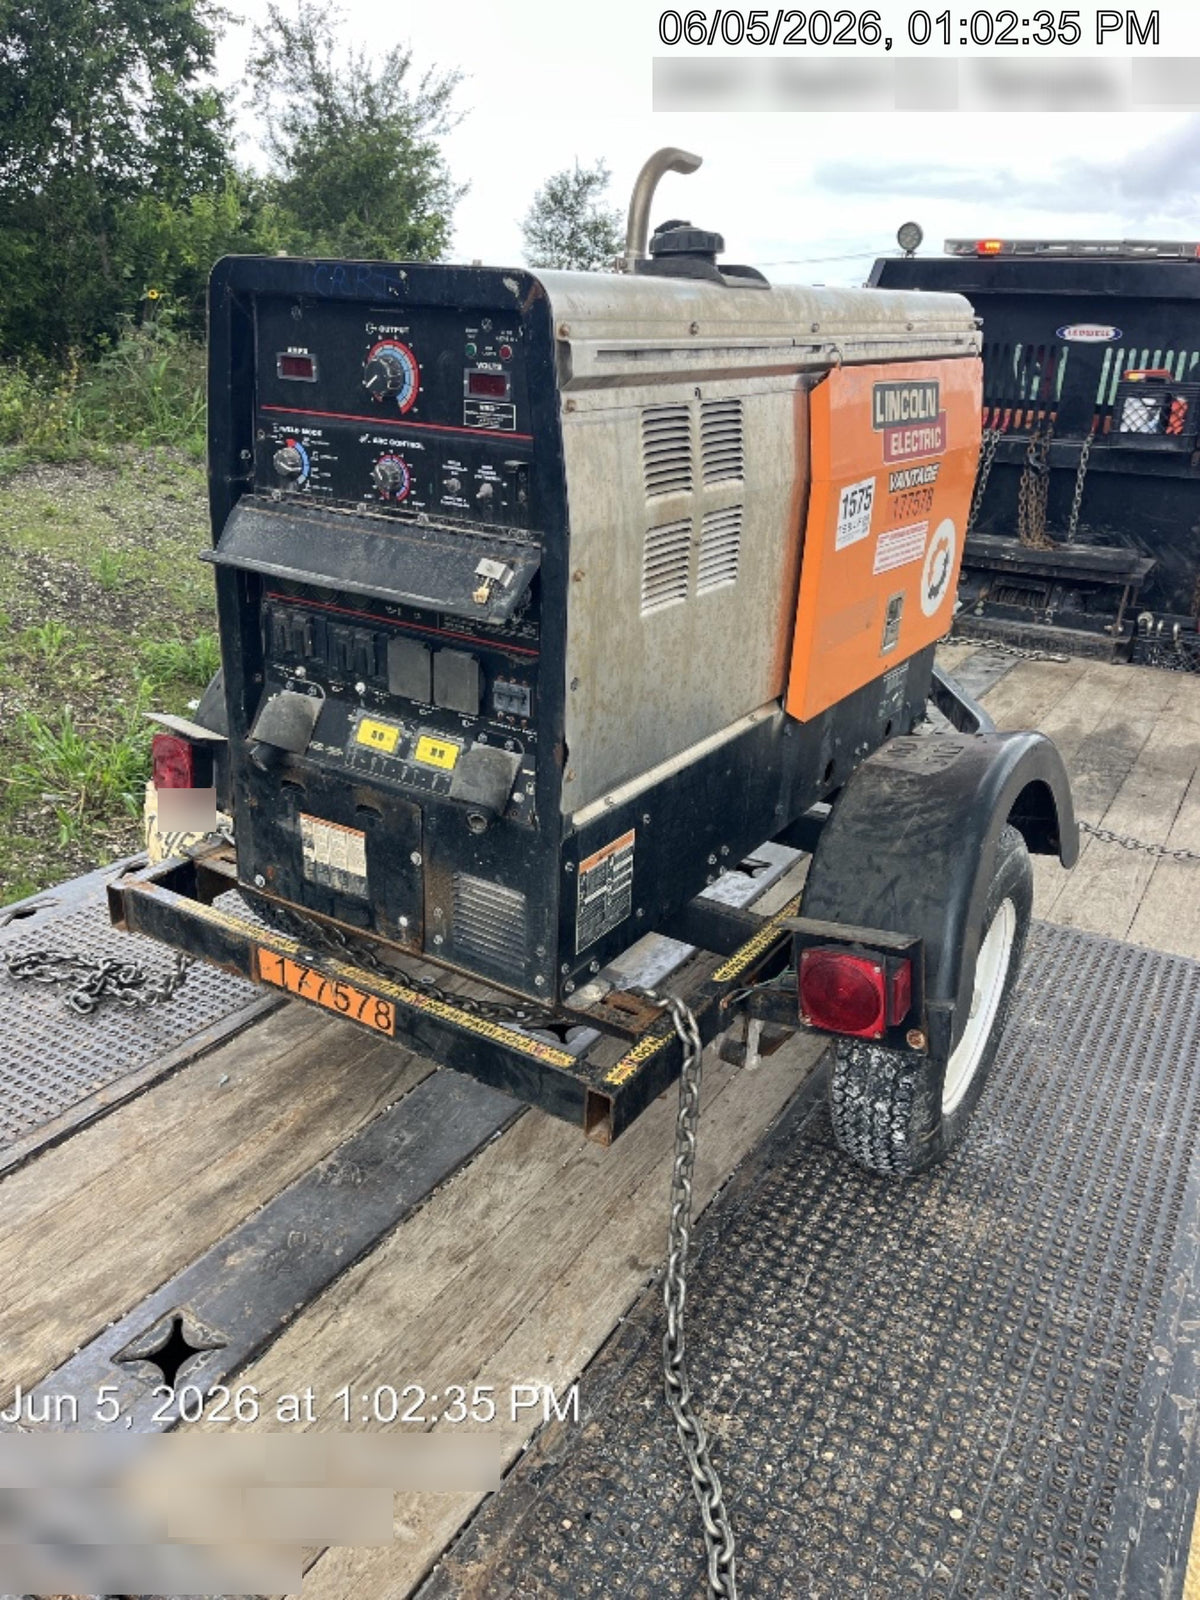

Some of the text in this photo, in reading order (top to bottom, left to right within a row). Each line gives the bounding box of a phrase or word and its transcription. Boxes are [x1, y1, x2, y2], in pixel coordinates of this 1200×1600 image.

[876, 387, 937, 424] LINCOLN
[890, 426, 942, 457] ELECTRIC
[888, 462, 941, 494] VANTAGE
[842, 485, 872, 520] 1575
[893, 486, 934, 519] 177578
[275, 957, 392, 1030] 177578
